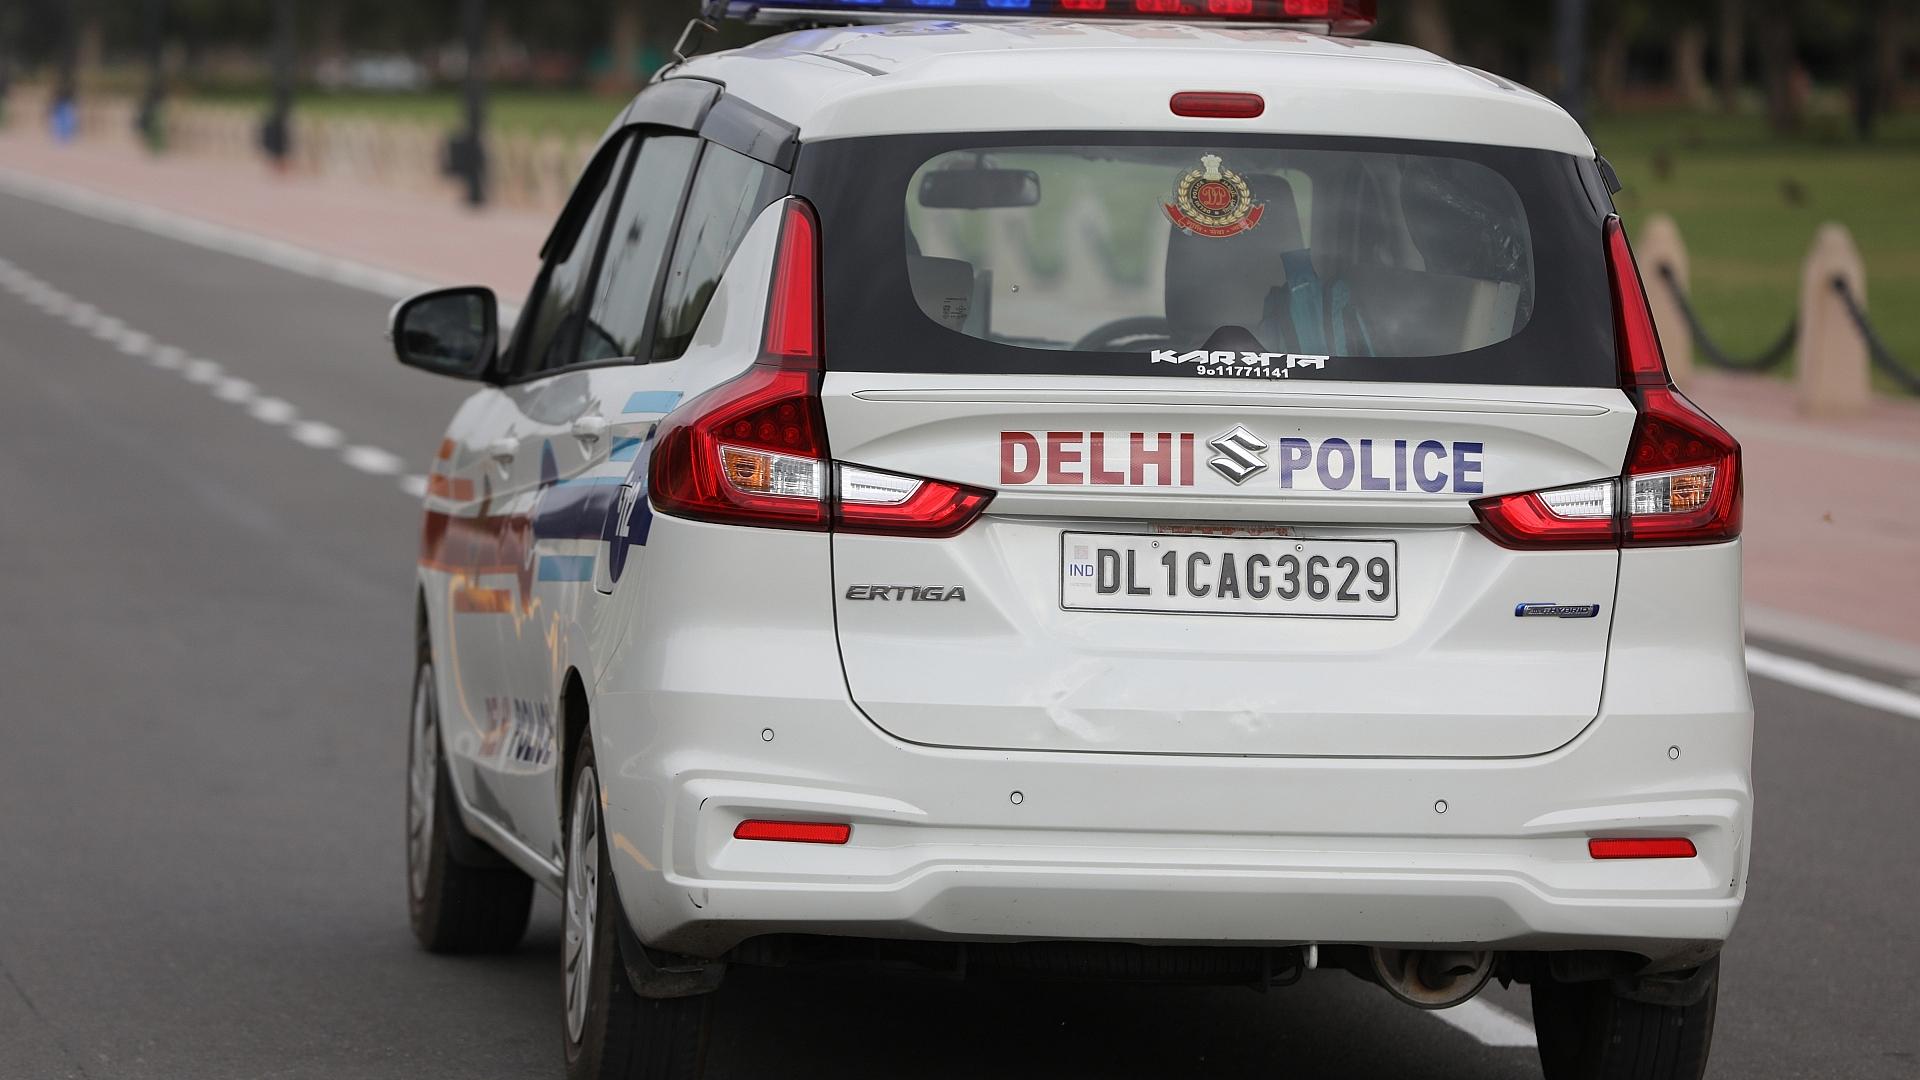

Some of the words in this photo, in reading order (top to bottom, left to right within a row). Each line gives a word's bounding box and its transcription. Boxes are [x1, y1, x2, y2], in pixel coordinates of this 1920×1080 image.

[1000, 431, 1194, 486] DELHI
[1280, 437, 1484, 493] POLICE
[1069, 563, 1094, 577] IND
[1097, 548, 1390, 602] DL1CAG3629
[845, 584, 966, 601] ERTIGA
